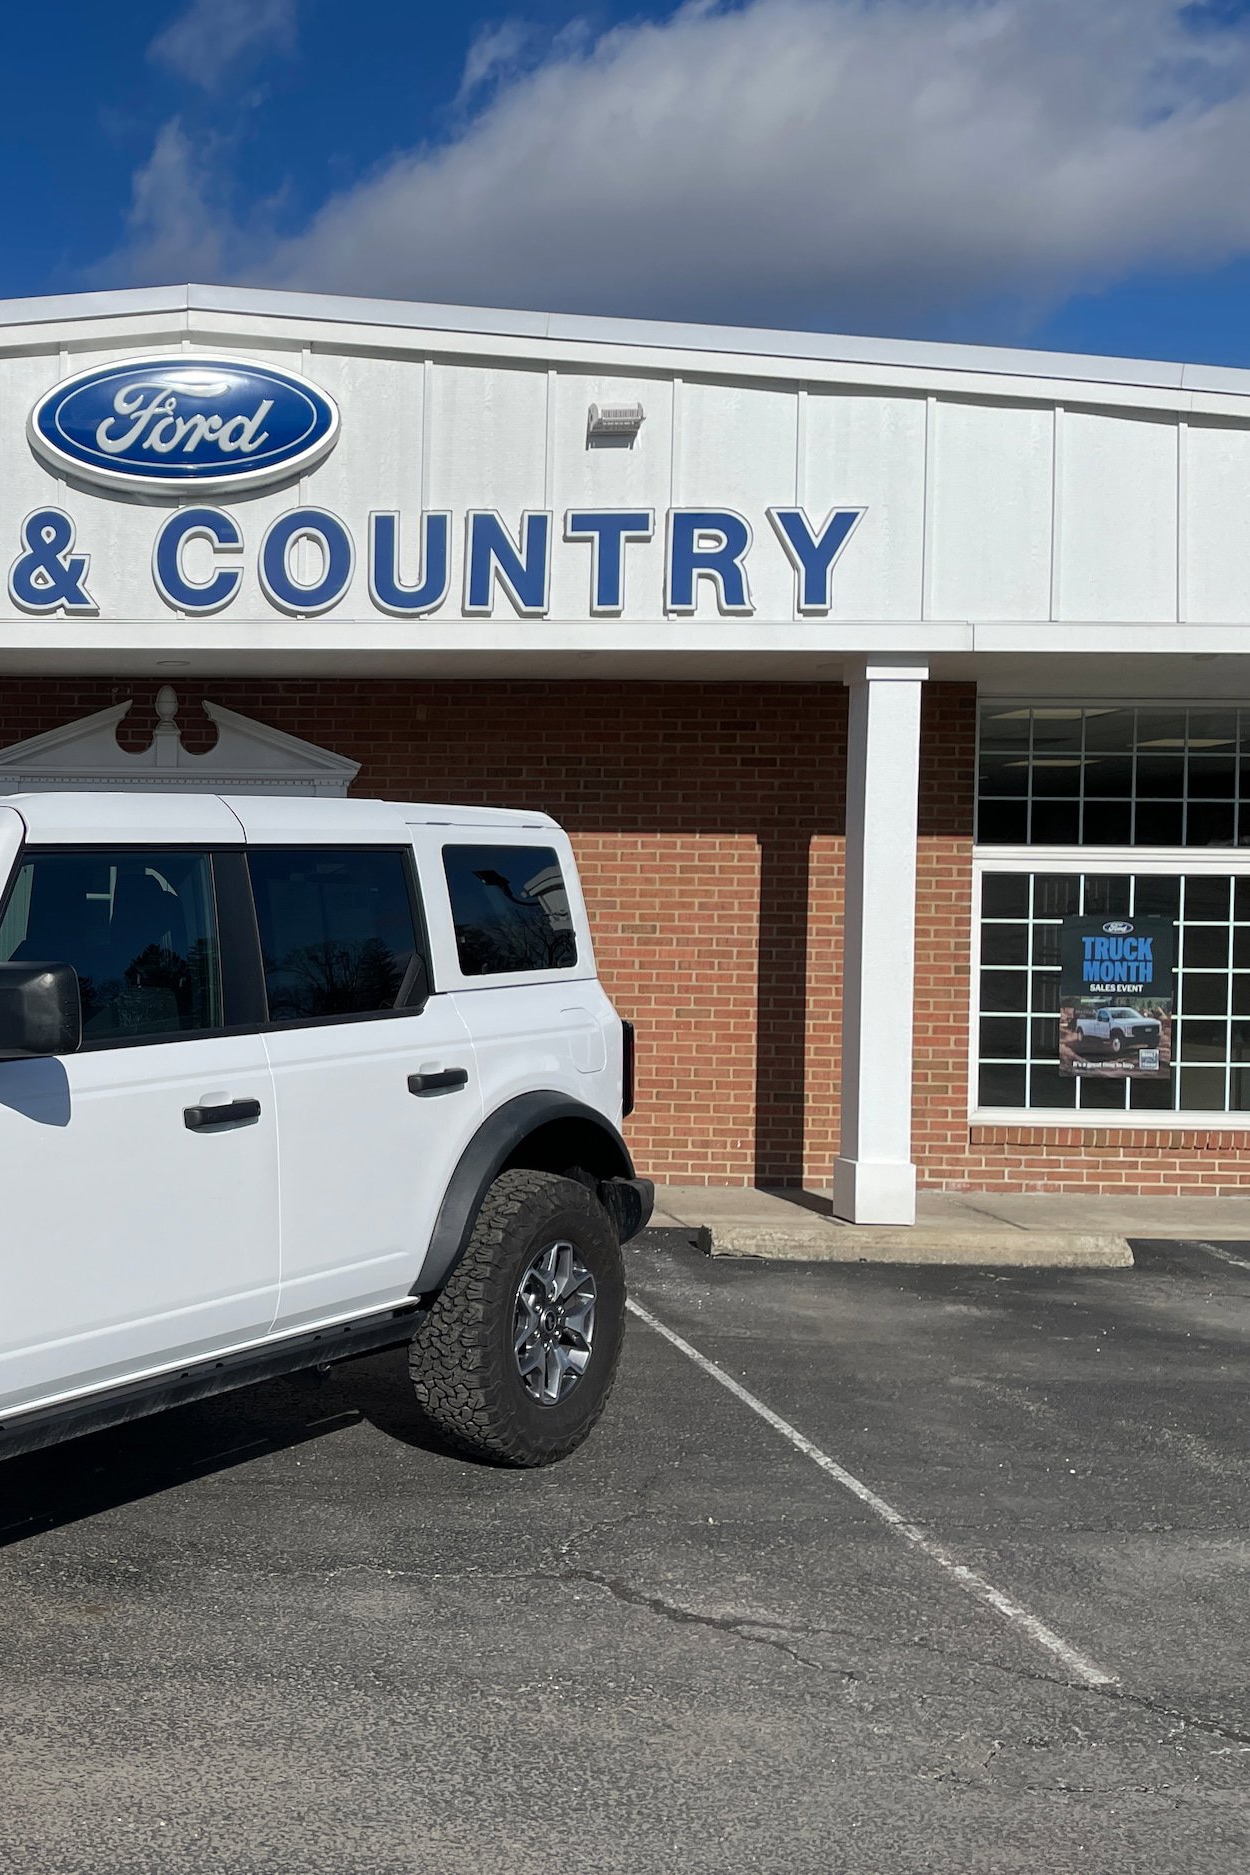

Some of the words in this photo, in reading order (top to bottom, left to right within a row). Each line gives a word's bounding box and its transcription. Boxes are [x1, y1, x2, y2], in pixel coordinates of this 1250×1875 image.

[96, 383, 275, 453] Ford
[8, 505, 99, 614] &
[152, 505, 869, 615] COUNTRY
[1081, 937, 1153, 960] TRUCK
[1082, 961, 1153, 983] MONTH
[1090, 984, 1116, 992] SALES
[1117, 984, 1143, 993] EVENT
